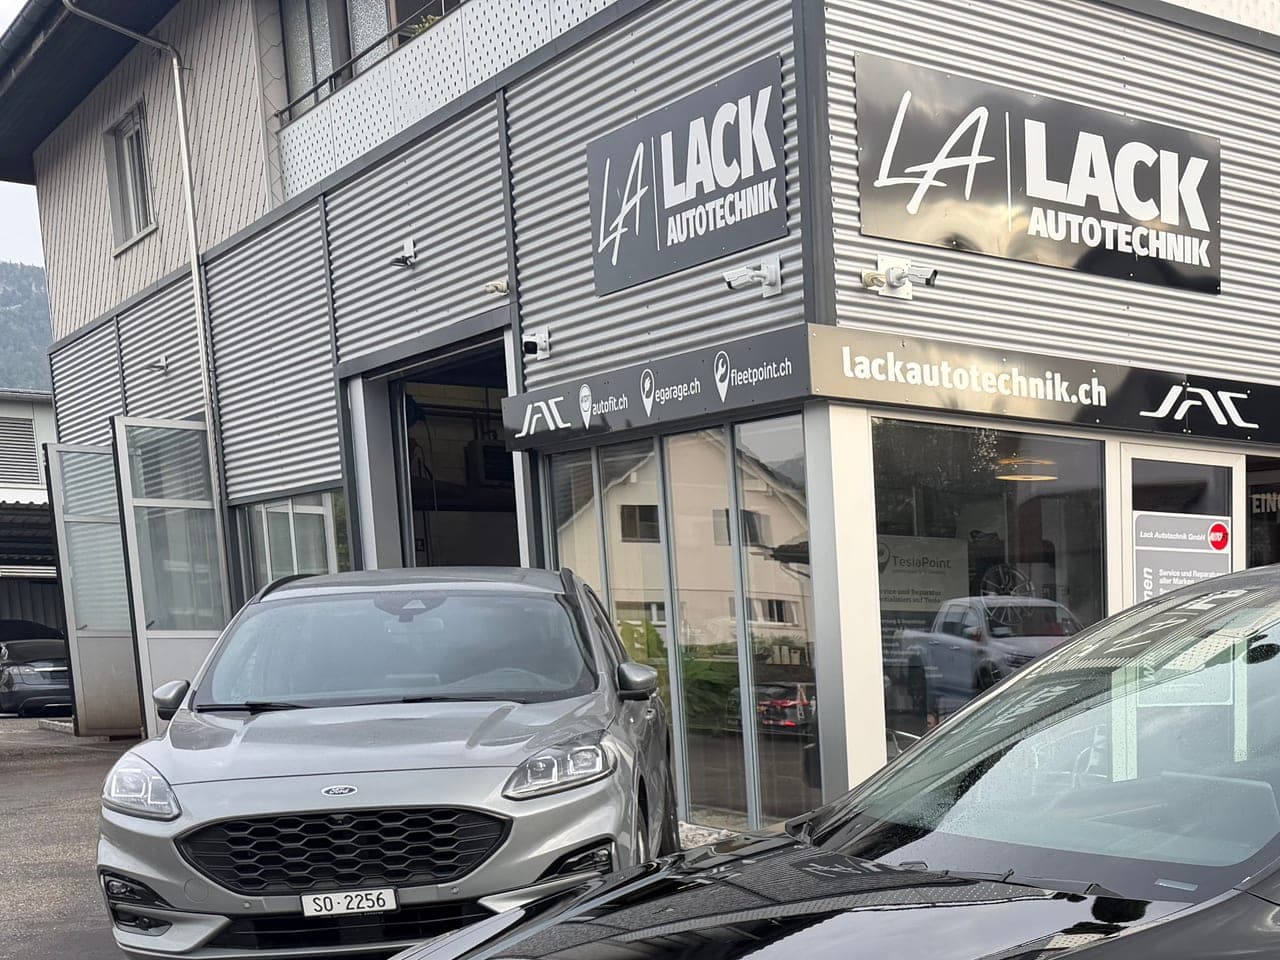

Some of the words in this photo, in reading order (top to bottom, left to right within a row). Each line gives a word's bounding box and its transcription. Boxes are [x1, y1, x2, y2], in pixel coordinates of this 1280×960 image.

[661, 85, 777, 209] LACK
[1024, 118, 1211, 232] LACK
[667, 178, 778, 246] AUTOTECHNIK
[1027, 206, 1211, 267] AUTOTECHNIK
[655, 377, 701, 405] egarage.ch
[730, 357, 792, 387] fleetpoint.ch
[842, 346, 1107, 407] lackautotechnik.ch
[592, 393, 628, 415] autofit.ch
[892, 555, 952, 569] TeslaPoint
